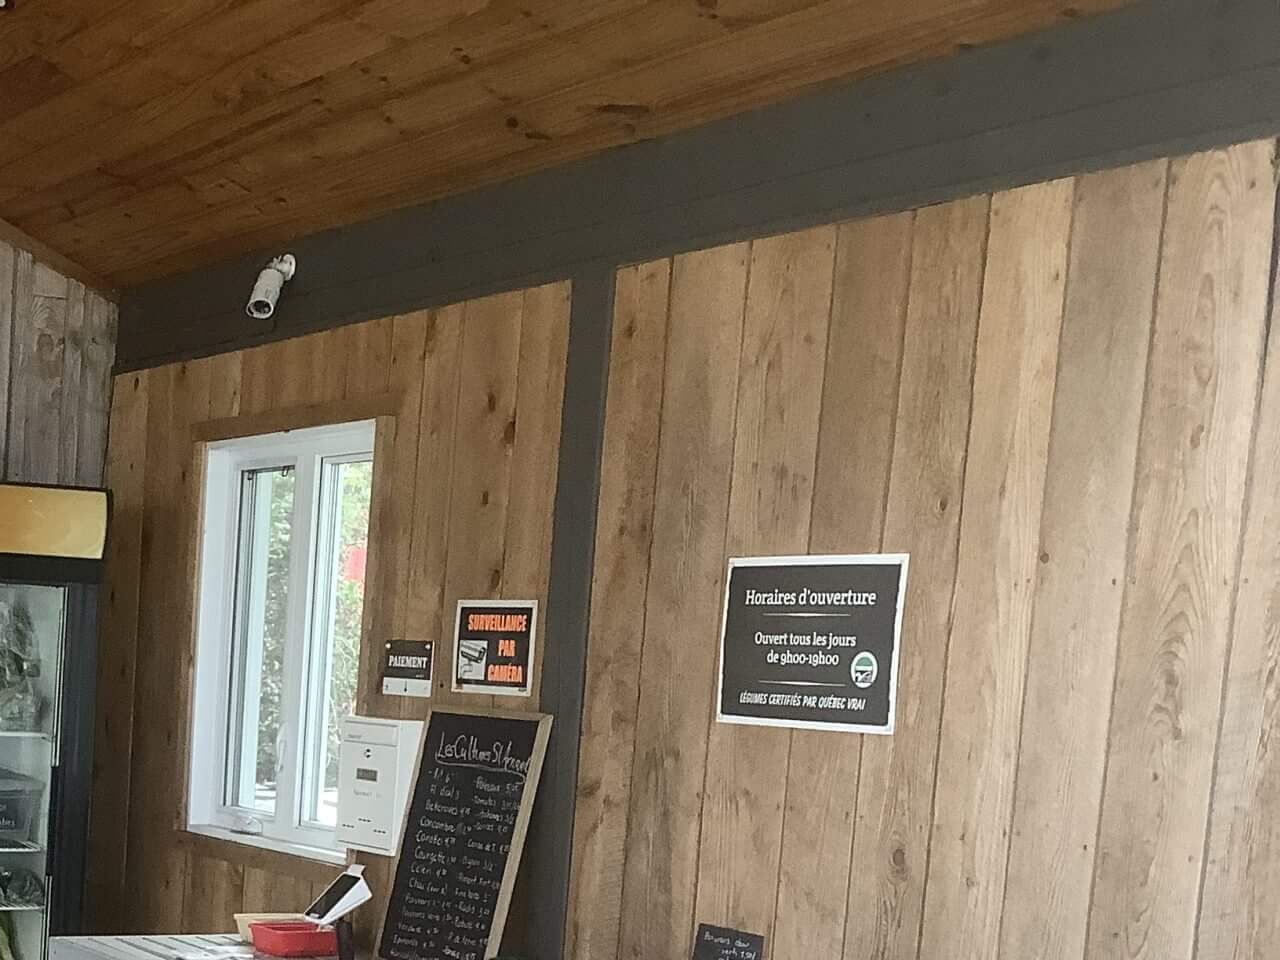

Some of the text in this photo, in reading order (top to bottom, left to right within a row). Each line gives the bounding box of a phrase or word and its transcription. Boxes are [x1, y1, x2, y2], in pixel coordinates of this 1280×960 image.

[745, 587, 877, 606] Horaires d'ouverture
[468, 614, 528, 632] SURVEILLANCE
[498, 639, 516, 657] PAR
[754, 632, 857, 649] Ouvert tous les jours
[388, 655, 427, 669] PAIEMENT
[767, 650, 839, 666] de 9h00-19h00
[487, 663, 523, 683] CAMÉRA
[739, 690, 866, 710] LÉGUMES CERTIFIÉS PAR QUÉBEC VRAI
